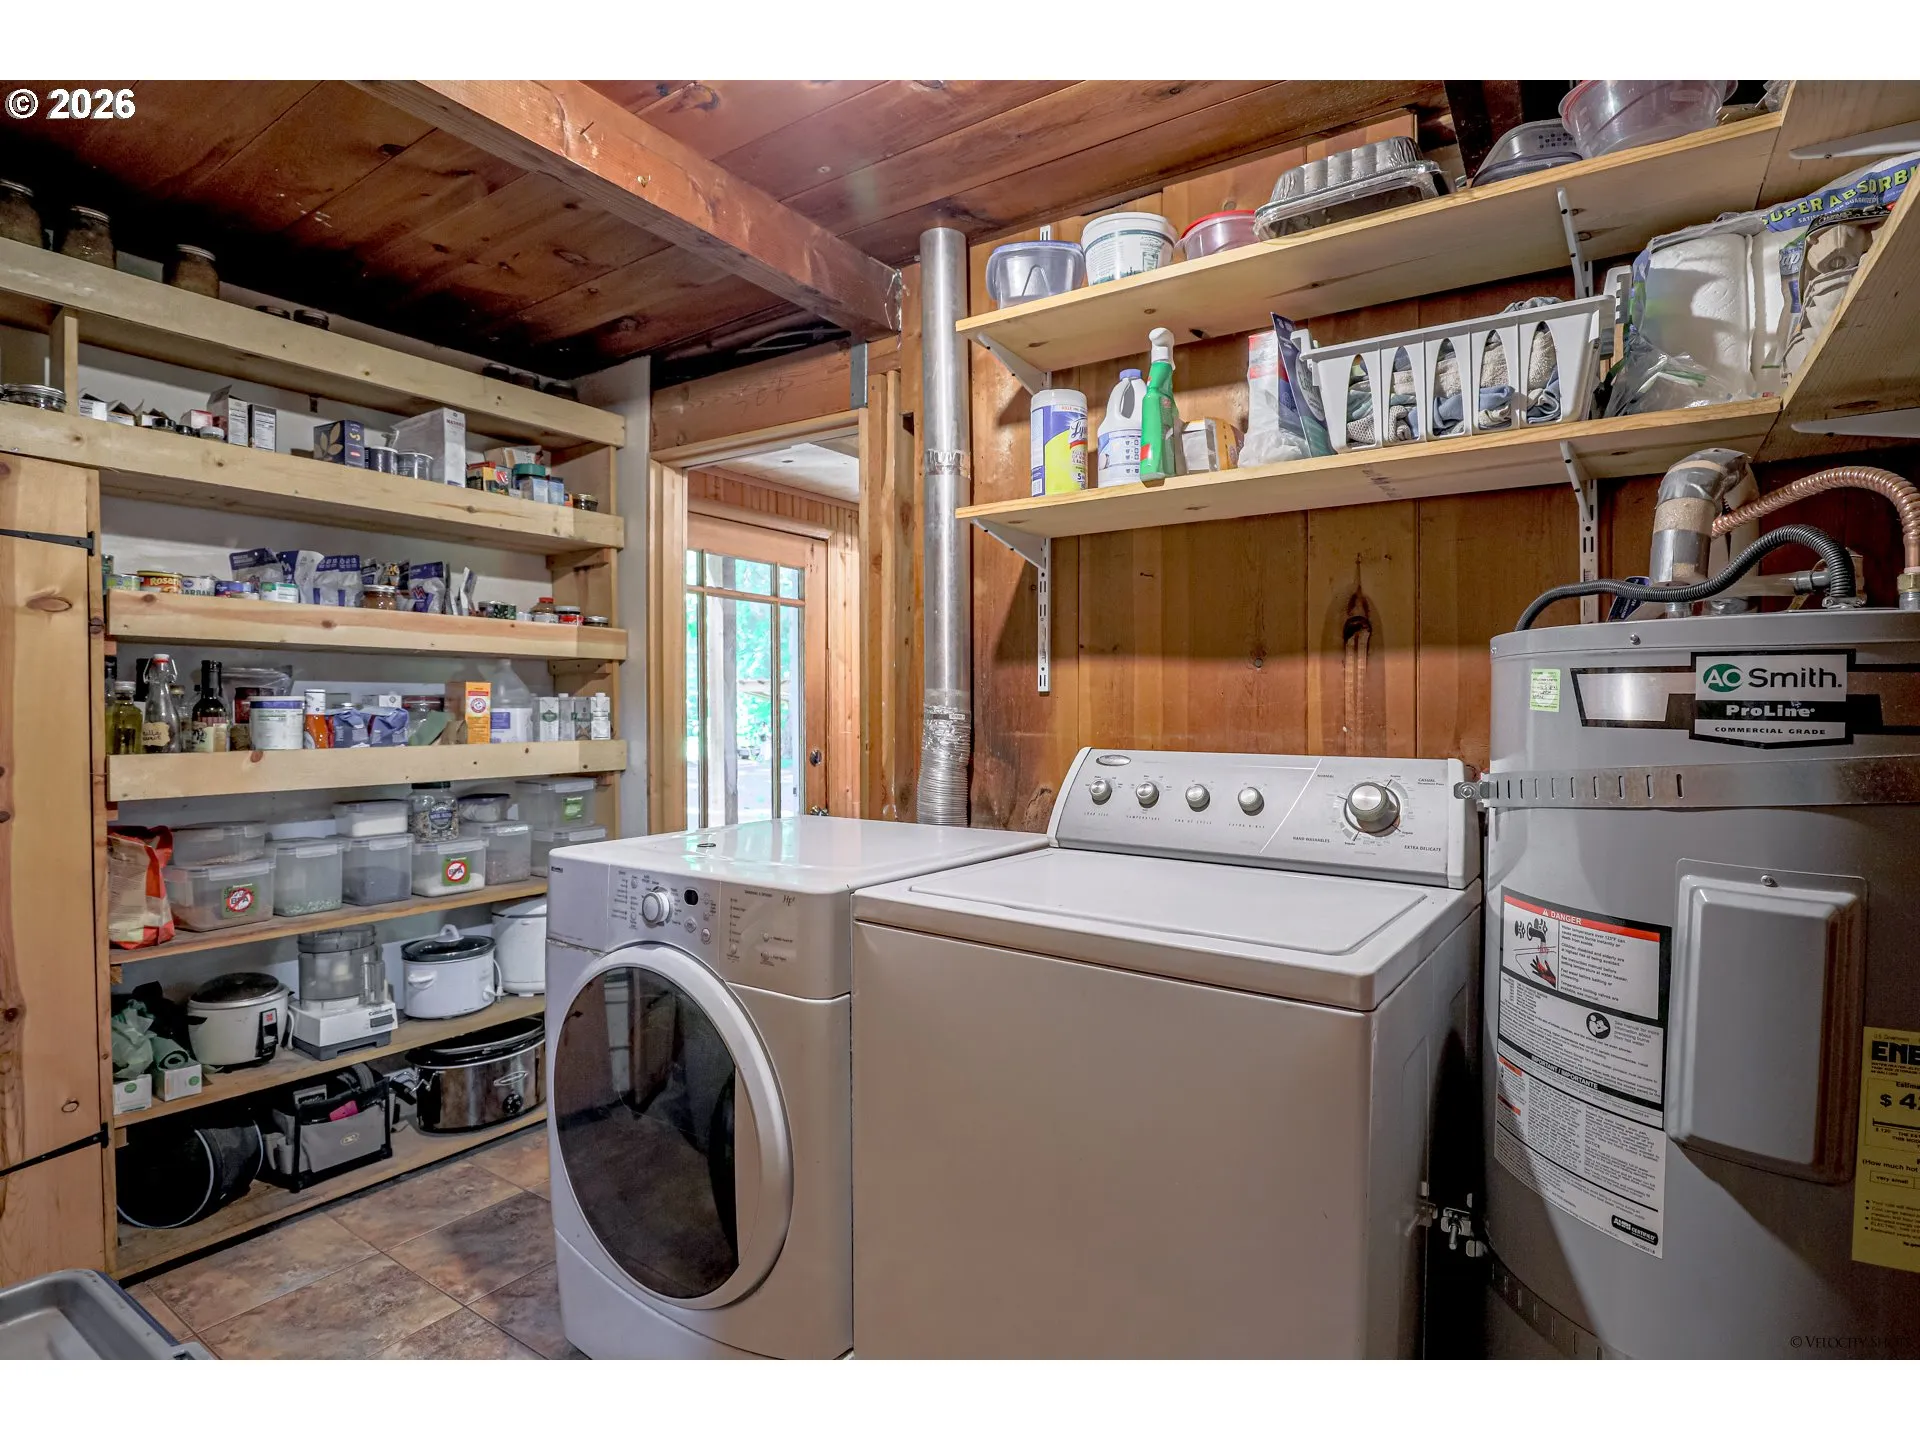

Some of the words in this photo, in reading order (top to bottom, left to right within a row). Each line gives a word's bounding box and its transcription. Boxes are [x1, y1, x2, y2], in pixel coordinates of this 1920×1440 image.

[1761, 197, 1824, 226] SUPER
[1704, 667, 1744, 688] AO
[1725, 704, 1810, 717] ProLine
[1714, 726, 1783, 735] COMMERCIAL
[1788, 728, 1826, 736] GRADE
[1550, 910, 1582, 925] DANGER
[1531, 1055, 1558, 1073] IMPORTANT
[1561, 1070, 1598, 1090] IMPORTANTE
[1880, 1094, 1892, 1107] $
[1899, 1094, 1920, 1110] 4
[1862, 1159, 1881, 1167] (How
[1883, 1162, 1904, 1171] much
[1906, 1165, 1918, 1173] hot
